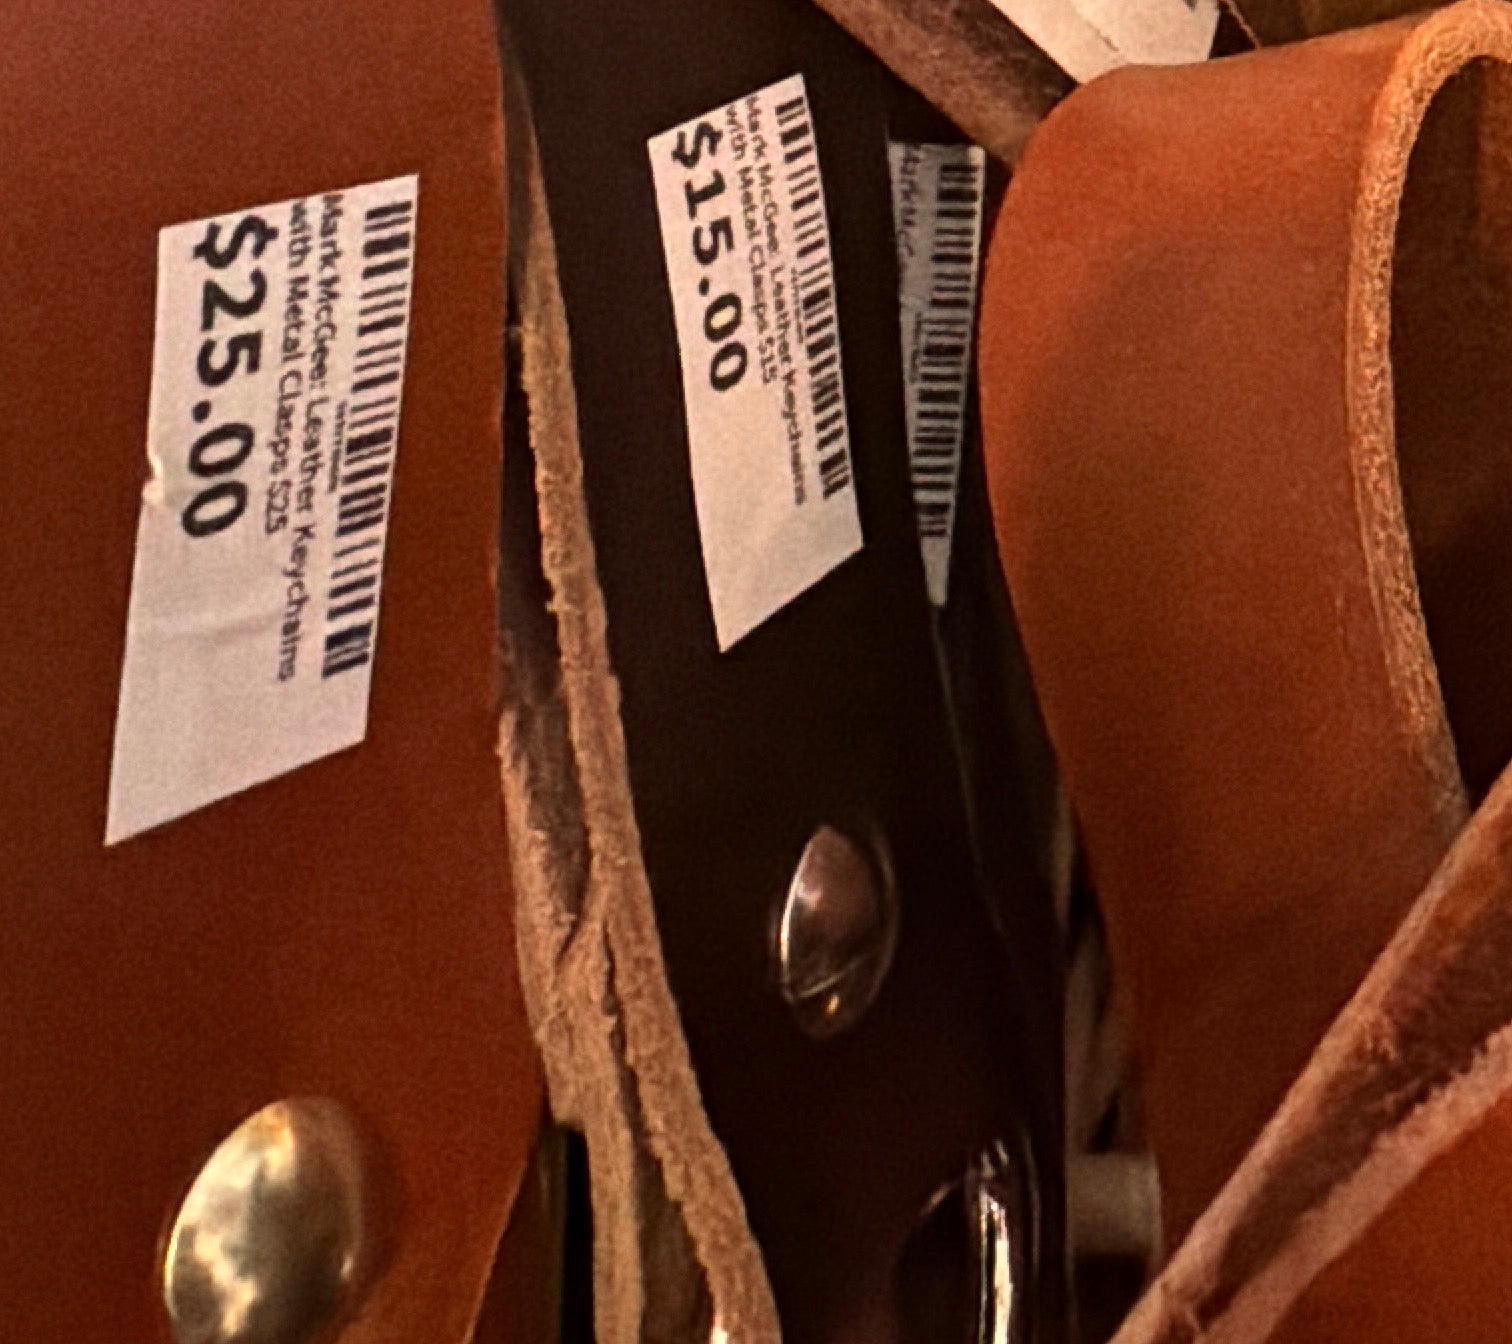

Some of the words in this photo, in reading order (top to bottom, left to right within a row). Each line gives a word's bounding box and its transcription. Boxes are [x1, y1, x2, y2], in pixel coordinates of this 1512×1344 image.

[318, 193, 344, 273] Mark
[671, 121, 749, 393] $15.00
[180, 214, 279, 539] $25.00
[281, 274, 310, 363] Metal
[267, 369, 304, 476] Clasps
[296, 395, 331, 513] Leather
[276, 522, 318, 682] Keychains
